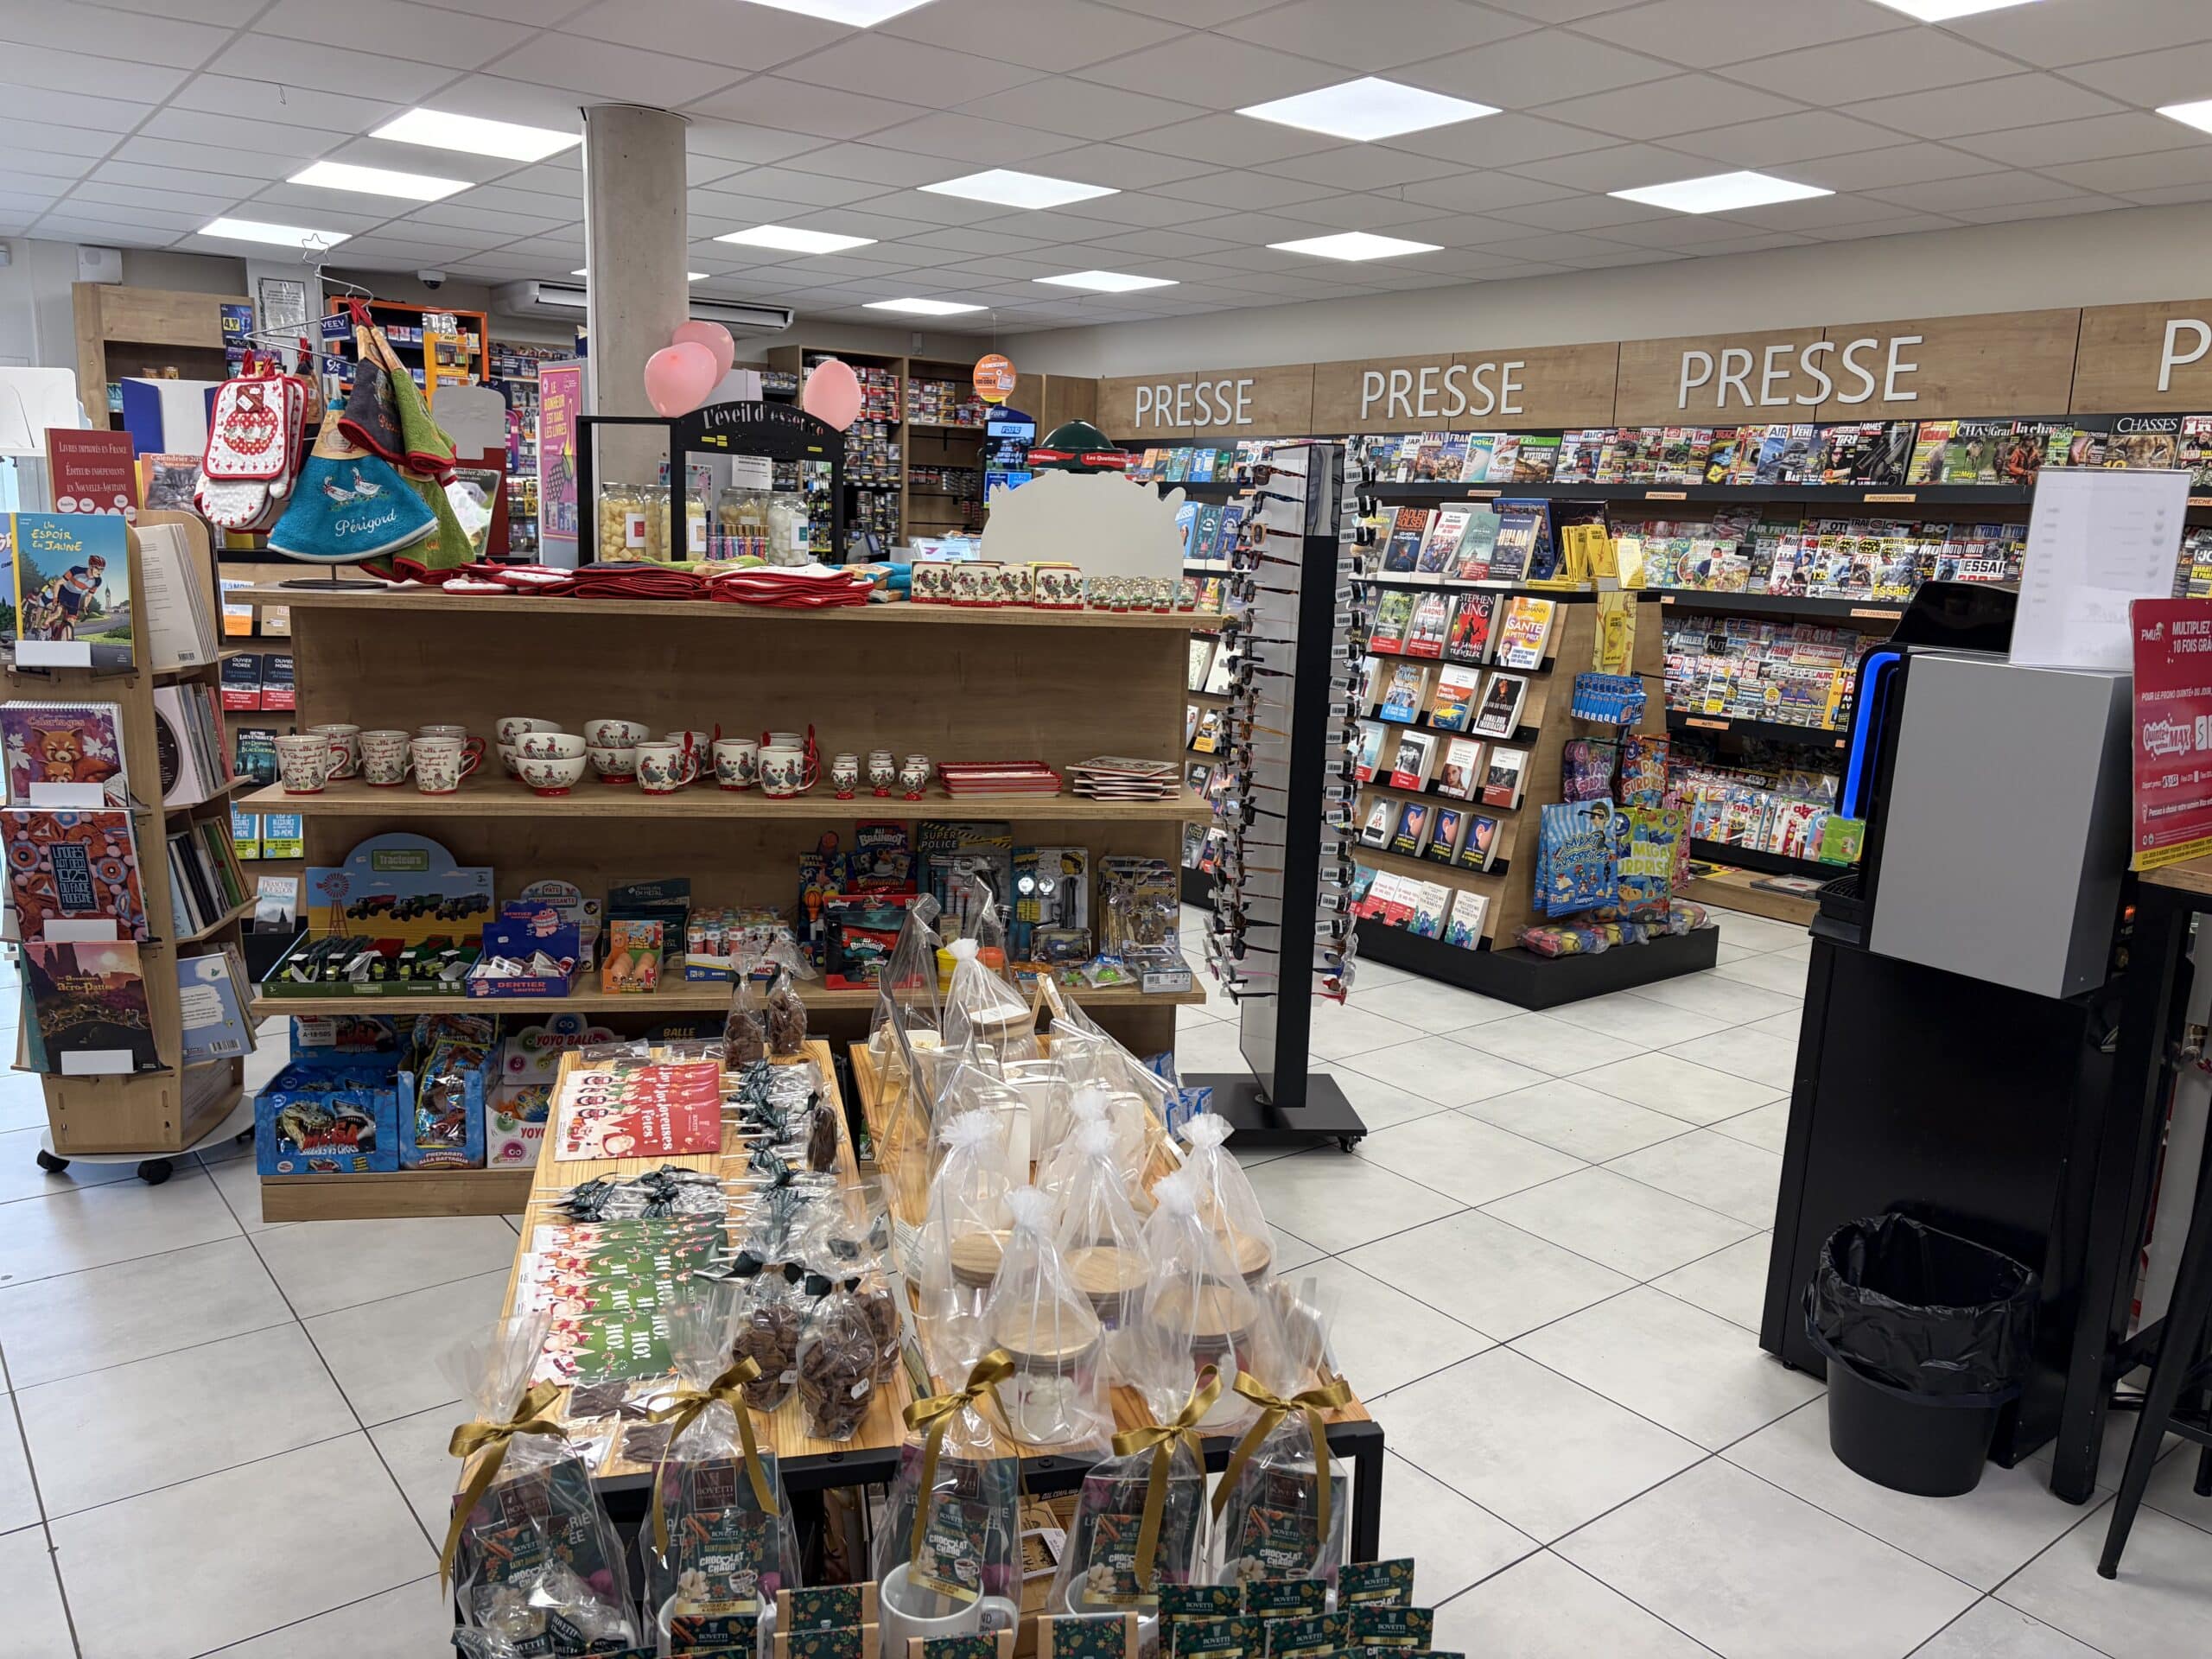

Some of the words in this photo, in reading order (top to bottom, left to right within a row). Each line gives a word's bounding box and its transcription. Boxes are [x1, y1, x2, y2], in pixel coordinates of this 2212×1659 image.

[321, 319, 345, 330] VEEV
[1677, 334, 1924, 410] PRESSE
[1361, 361, 1525, 420] PRESSE
[1135, 379, 1254, 428] PRESSE
[702, 403, 751, 429] L'éveil
[2117, 416, 2177, 433] CHASSES
[1769, 426, 1787, 437] AIR
[109, 442, 127, 454] FRANCE
[335, 508, 397, 537] Périgord
[1750, 524, 1767, 533] AIR
[1770, 524, 1798, 534] FRYER
[44, 540, 83, 552] JAUNE
[1459, 593, 1495, 605] STEPHEN
[1459, 603, 1488, 617] KING
[1508, 618, 1544, 632] SANTÉ
[2141, 628, 2158, 641] PMU
[2172, 620, 2210, 635] MULTIPLIEZ
[2182, 639, 2197, 653] FOIS
[2170, 728, 2190, 747] MAX
[859, 833, 906, 846] BRAINROT
[924, 830, 957, 840] SUPER
[922, 840, 958, 849] POLICE
[1564, 834, 1599, 850] MAXI
[53, 846, 85, 858] LIMOGES
[1631, 842, 1670, 860] MEGA
[1618, 858, 1670, 877] URPRISE
[57, 869, 89, 882] 1925
[850, 942, 887, 952] BRAINROT
[664, 1028, 696, 1037] BALLE
[536, 1035, 564, 1046] YOYO
[566, 1035, 594, 1046] BALL
[641, 1109, 655, 1137] Fêtes
[657, 1103, 673, 1150] Joyeuses
[605, 1324, 626, 1351] HO!
[631, 1331, 652, 1360] HO!
[697, 1485, 733, 1495] BOVETTI
[936, 1544, 961, 1557] CHAUD
[709, 1564, 735, 1573] CHAUD
[1267, 1557, 1294, 1567] CHAUD
[1203, 1637, 1230, 1645] BOVETTI
[1296, 1632, 1323, 1642] BOVETTI
